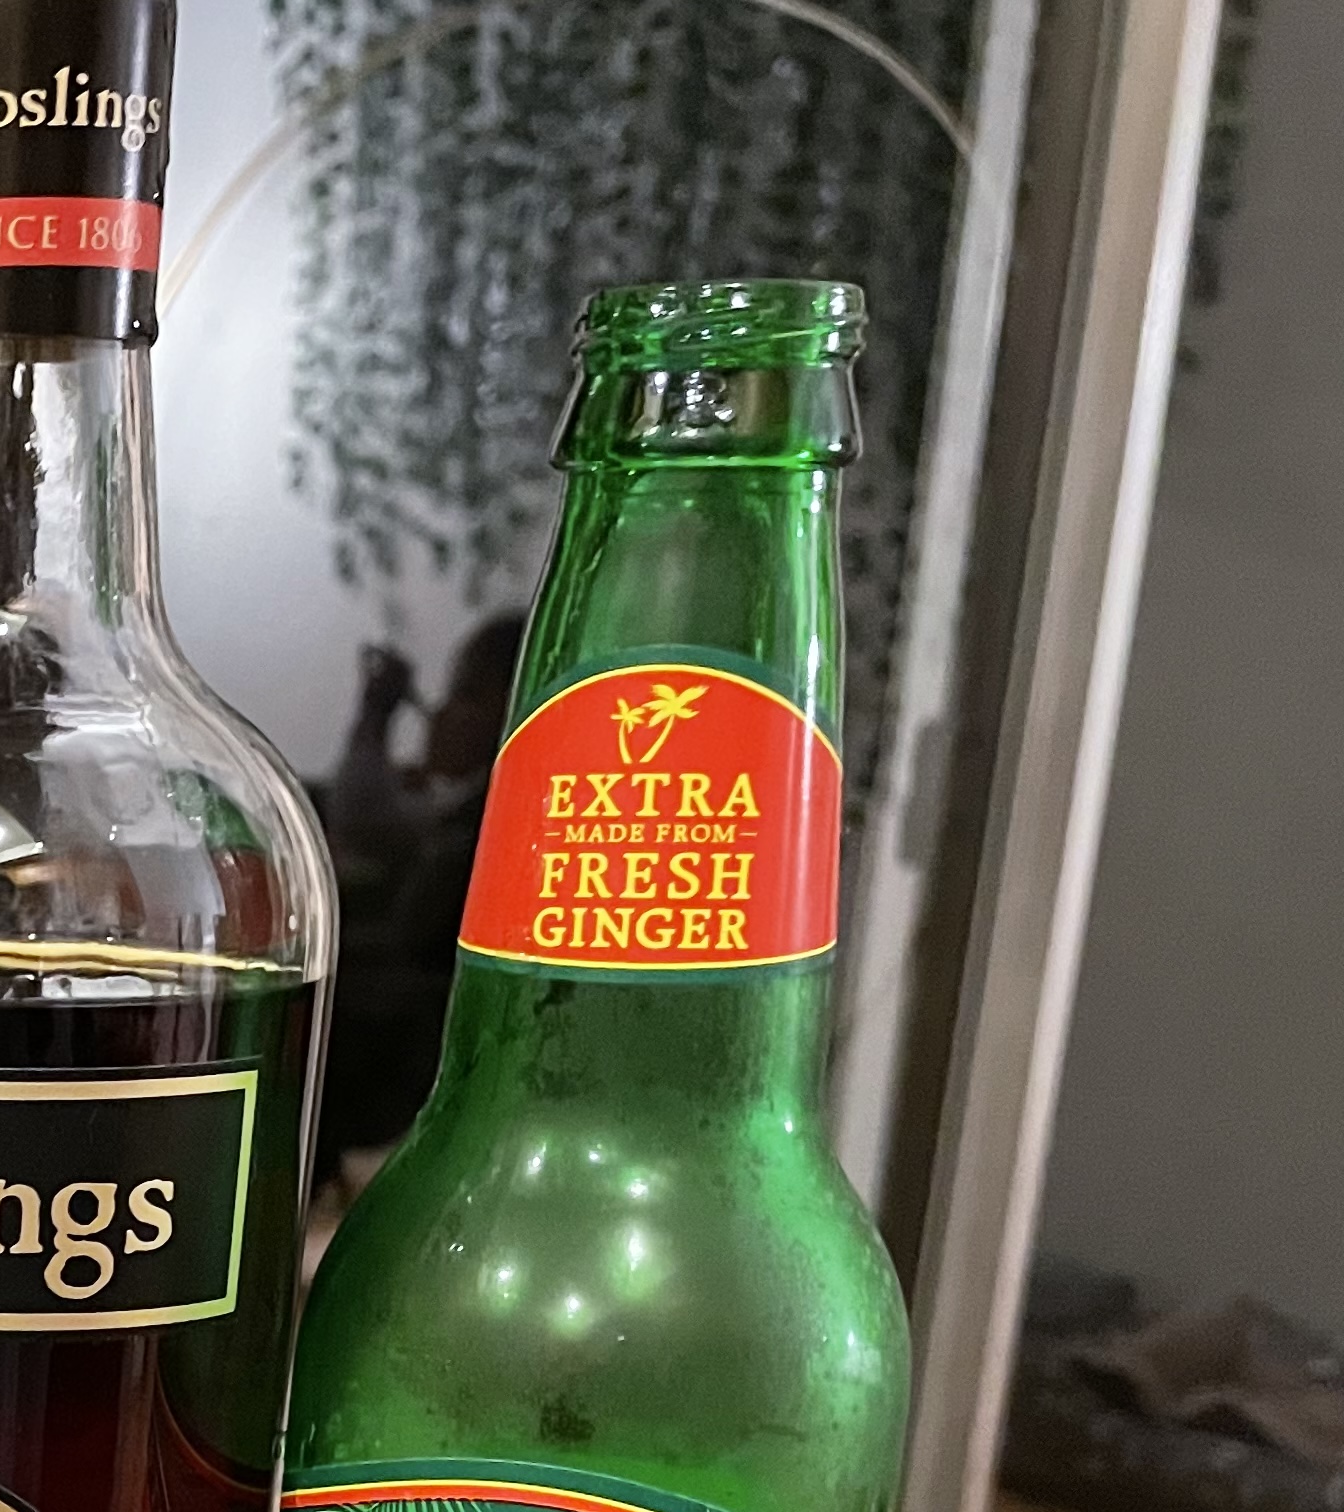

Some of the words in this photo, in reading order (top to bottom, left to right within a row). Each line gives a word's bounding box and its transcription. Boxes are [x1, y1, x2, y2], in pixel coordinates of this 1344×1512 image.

[545, 773, 761, 818] EXTRA
[563, 824, 645, 844] MADE
[655, 824, 737, 844] FROM
[538, 852, 755, 900] FRESH
[532, 907, 749, 950] GINGER
